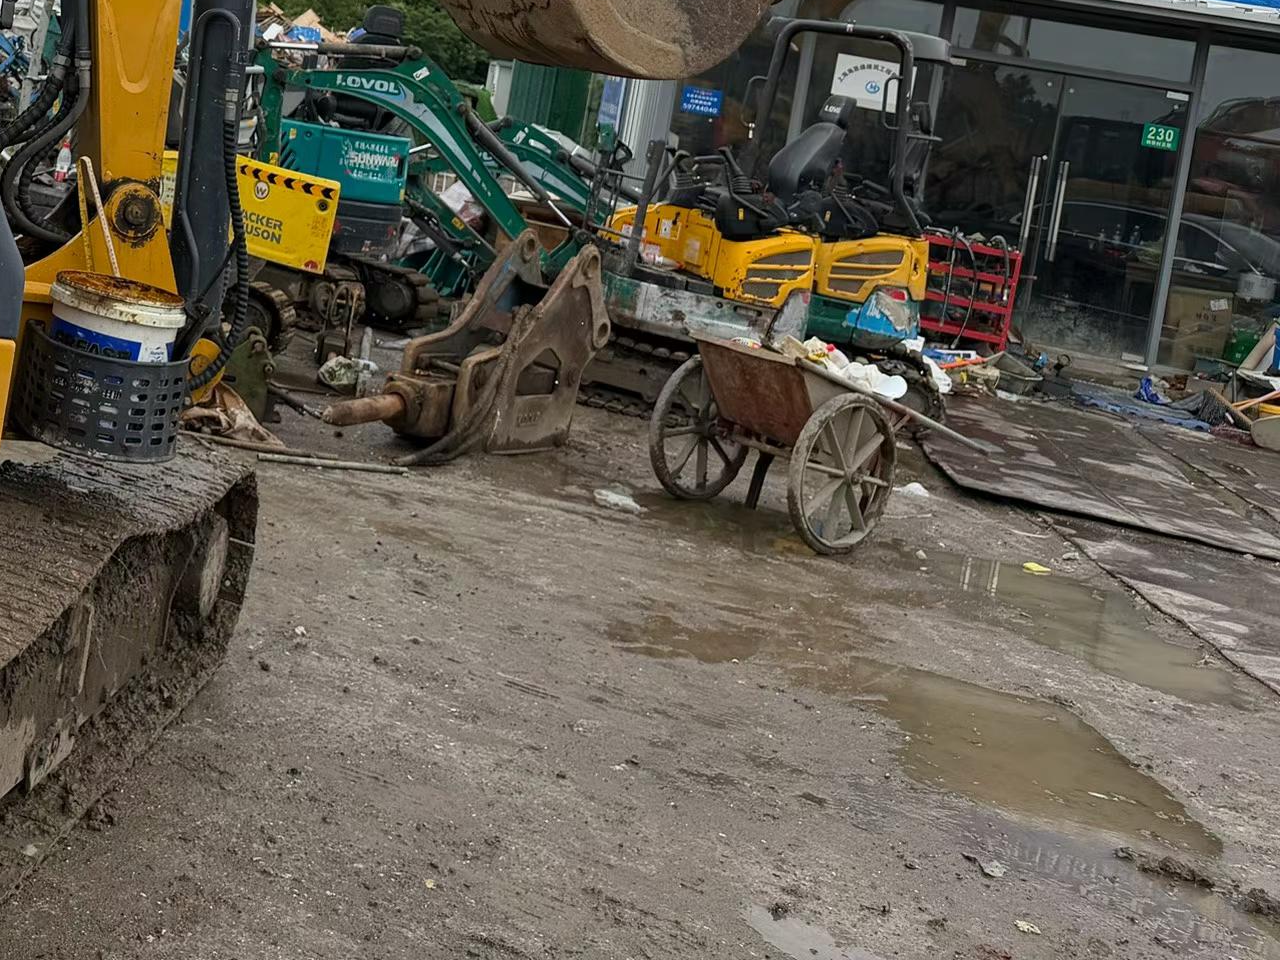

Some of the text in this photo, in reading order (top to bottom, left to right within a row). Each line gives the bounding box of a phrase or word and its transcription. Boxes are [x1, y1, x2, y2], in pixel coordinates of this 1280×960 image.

[1147, 126, 1174, 142] 230
[242, 209, 283, 232] ACKER
[243, 222, 282, 245] USON
